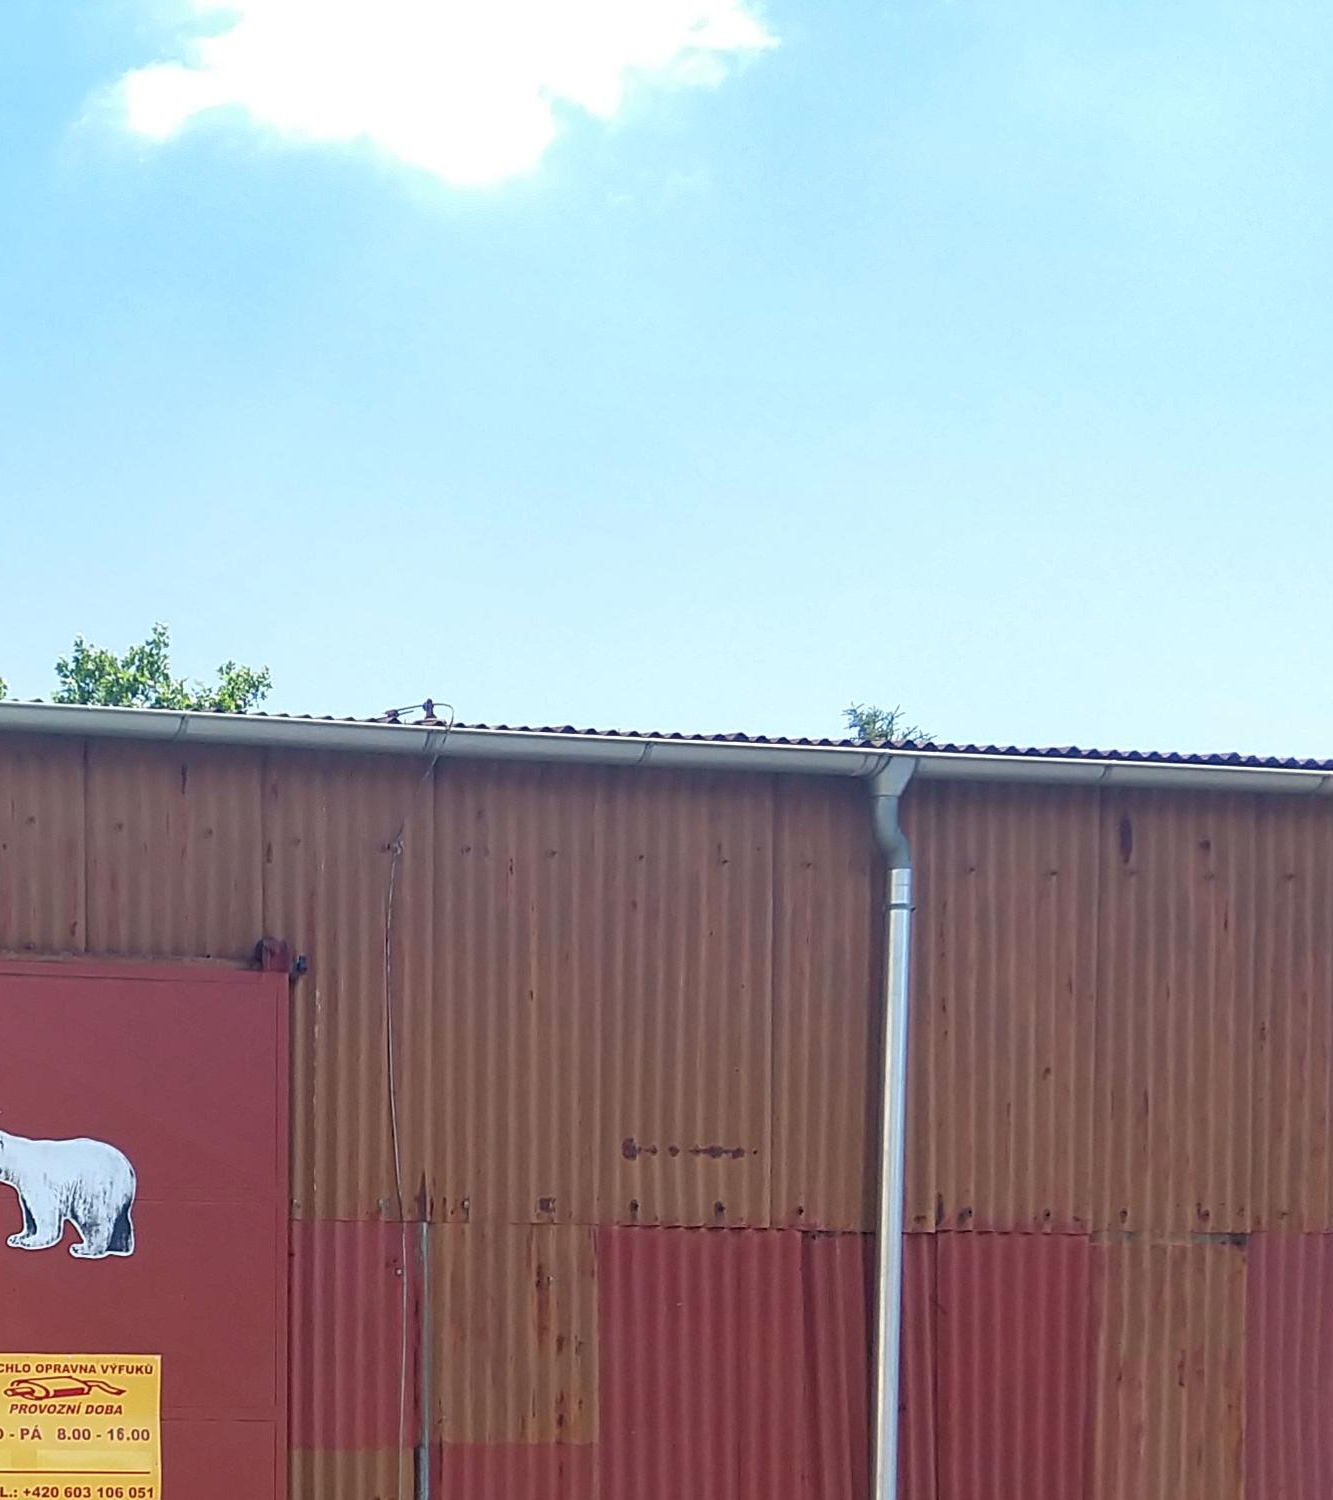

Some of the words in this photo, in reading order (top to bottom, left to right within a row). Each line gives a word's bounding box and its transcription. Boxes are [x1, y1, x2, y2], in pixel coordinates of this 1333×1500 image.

[35, 1364, 96, 1374] OPRAVNA
[9, 1402, 82, 1414] PROVOZNÍ
[85, 1405, 123, 1414] DOBA
[20, 1425, 41, 1440] PÁ
[57, 1429, 91, 1440] 8.00
[107, 1428, 150, 1441] 16.00
[23, 1487, 59, 1498] +420
[64, 1487, 91, 1498] 603
[97, 1488, 123, 1498] 106
[129, 1488, 153, 1498] 051
